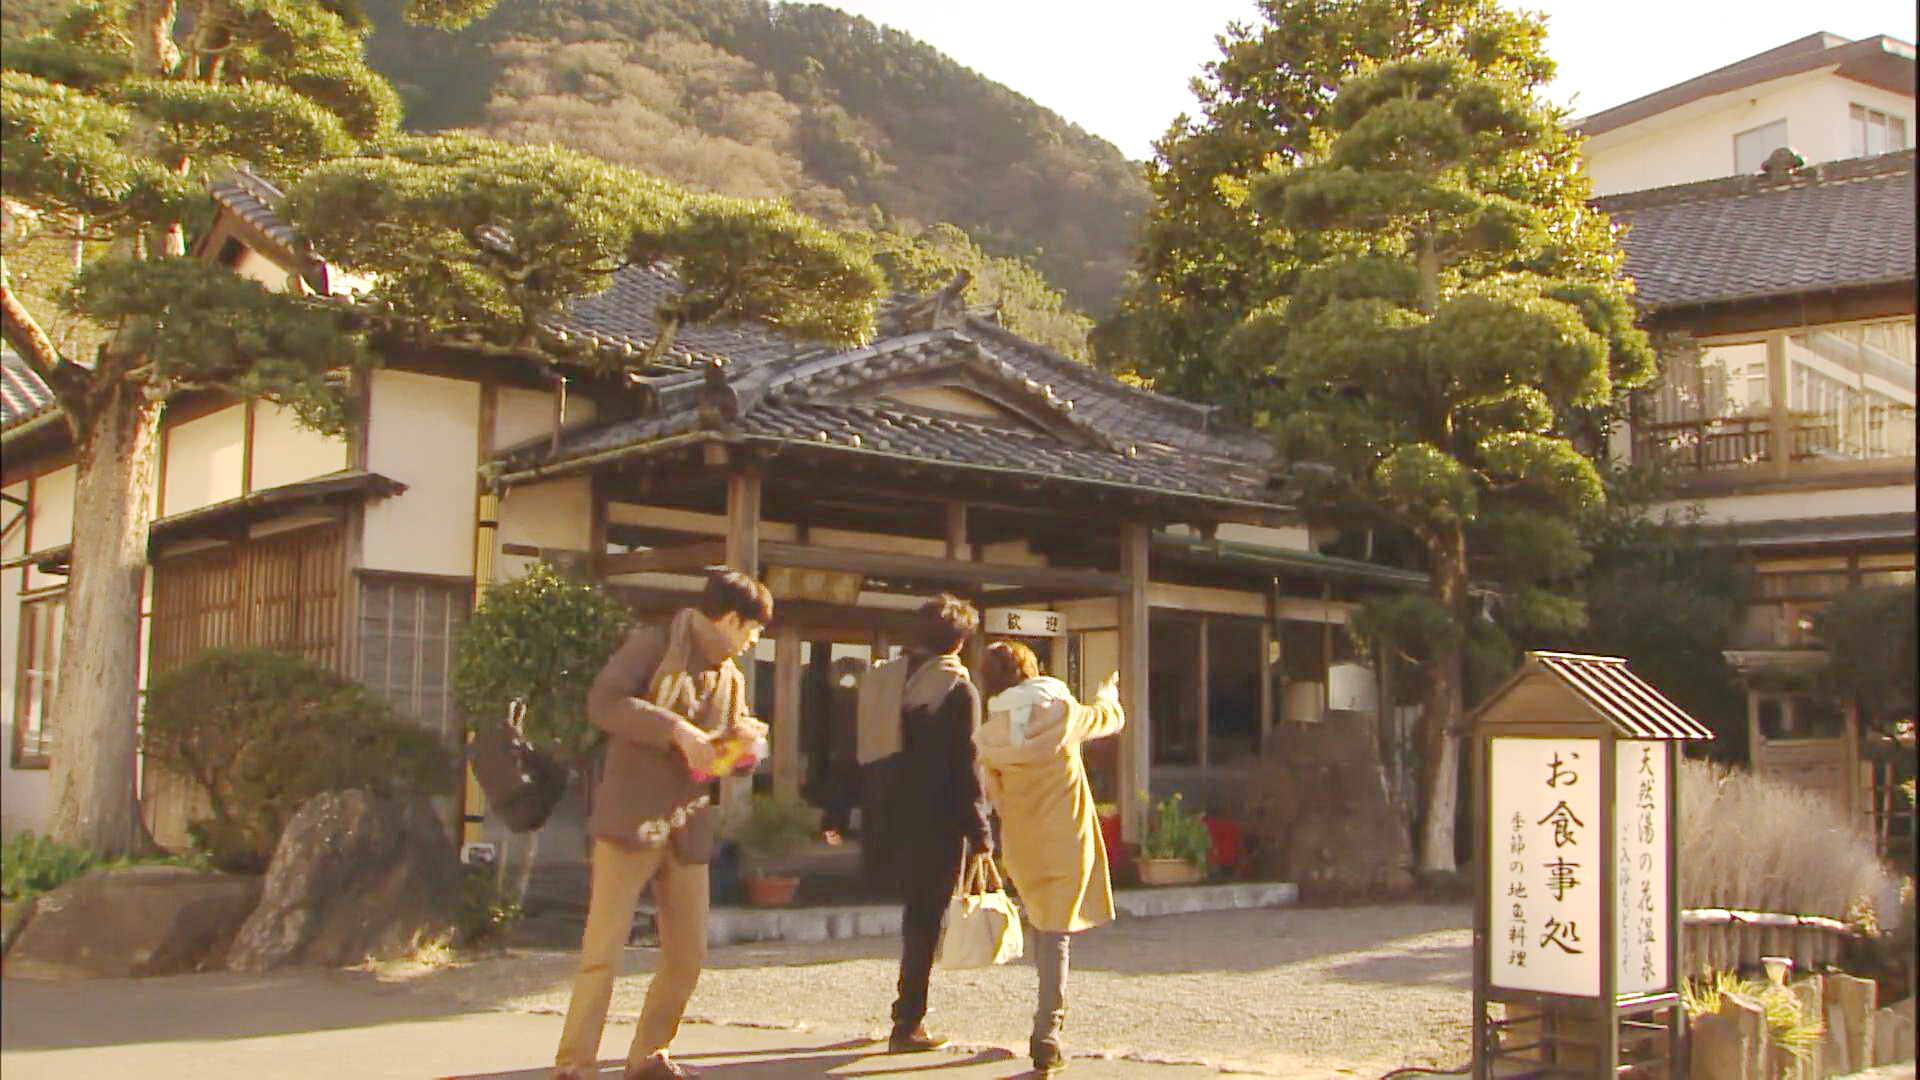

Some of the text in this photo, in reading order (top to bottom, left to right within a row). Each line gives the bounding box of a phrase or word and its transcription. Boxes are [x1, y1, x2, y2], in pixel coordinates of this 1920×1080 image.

[1507, 811, 1529, 967] 季節の地魚料理
[1537, 751, 1584, 955] お食事処
[1637, 747, 1656, 983] 天然湯の花温泉
